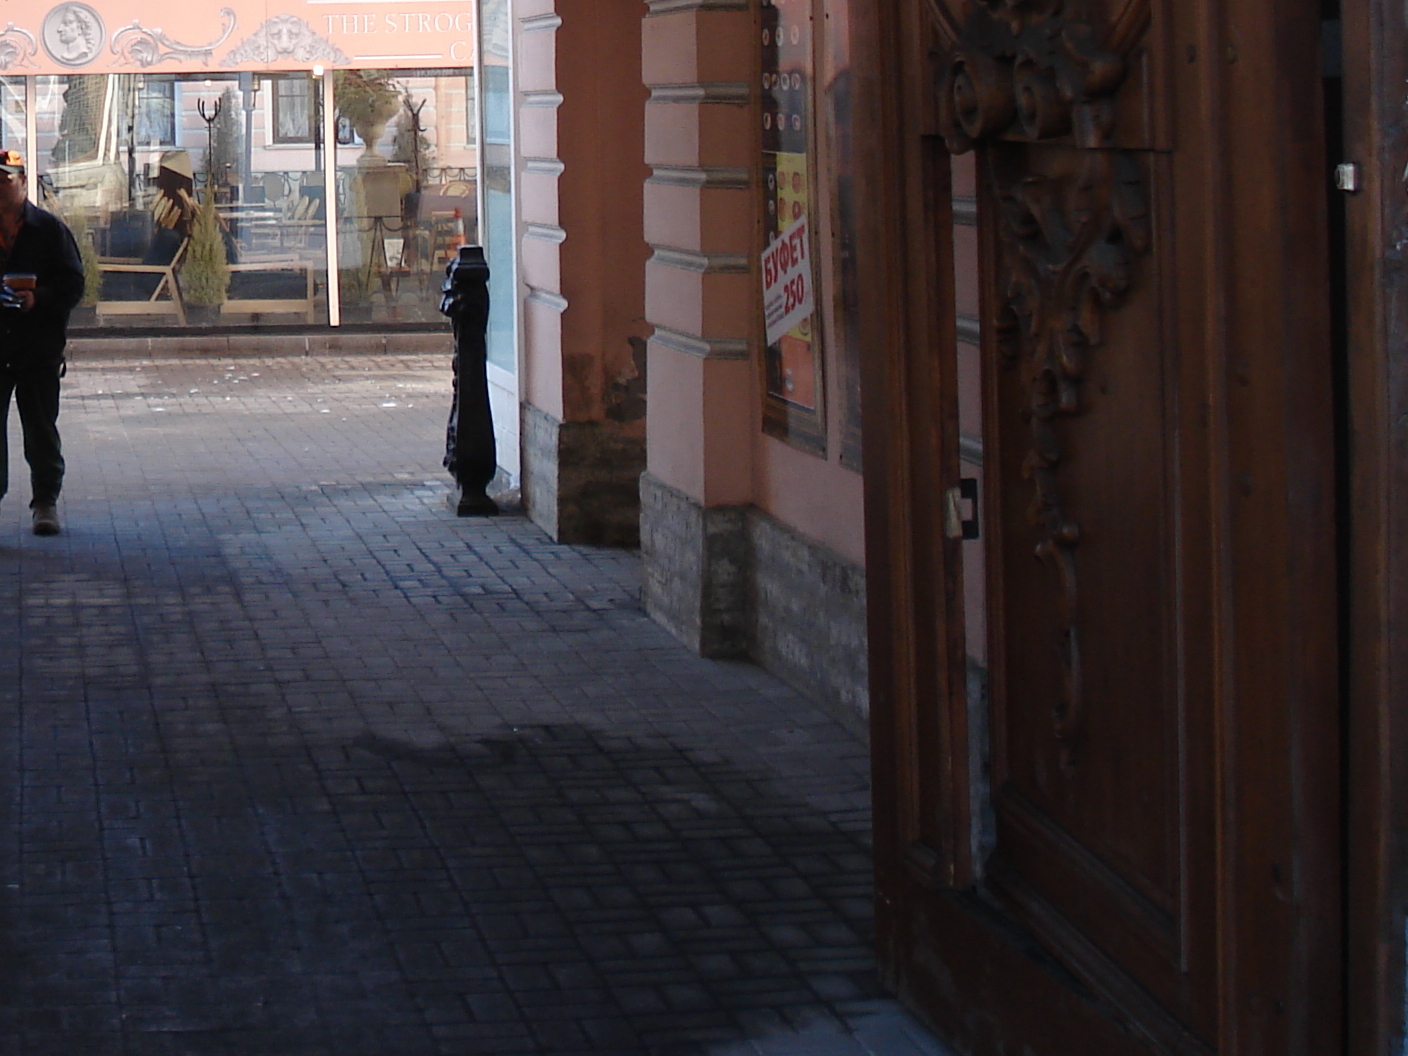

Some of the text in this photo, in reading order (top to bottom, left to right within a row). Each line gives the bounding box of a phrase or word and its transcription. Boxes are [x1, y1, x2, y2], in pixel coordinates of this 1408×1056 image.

[322, 13, 378, 35] THE
[449, 41, 474, 61] C
[764, 224, 806, 290] БУФЕТ
[783, 273, 805, 316] 250
